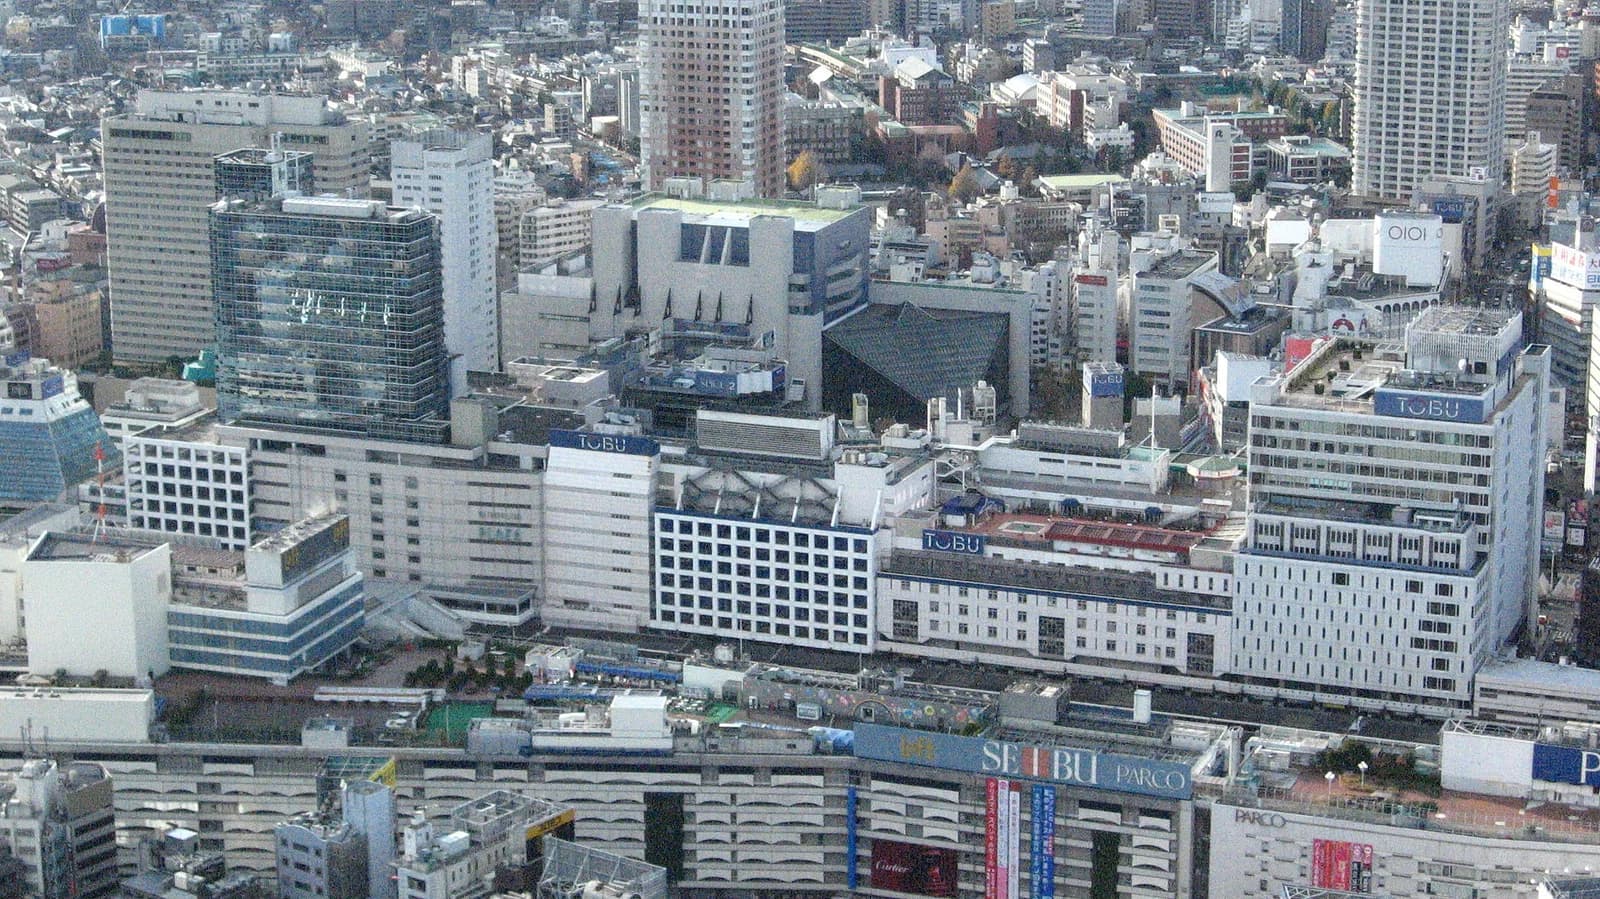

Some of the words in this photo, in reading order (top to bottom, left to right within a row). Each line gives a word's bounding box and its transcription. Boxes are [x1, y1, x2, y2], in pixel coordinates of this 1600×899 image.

[1397, 397, 1459, 418] TOBU
[578, 434, 626, 452] TOBU
[925, 532, 979, 553] TOBU
[982, 741, 1098, 785] SEIBU
[1116, 763, 1186, 790] PARCO
[1234, 809, 1287, 829] PARCO
